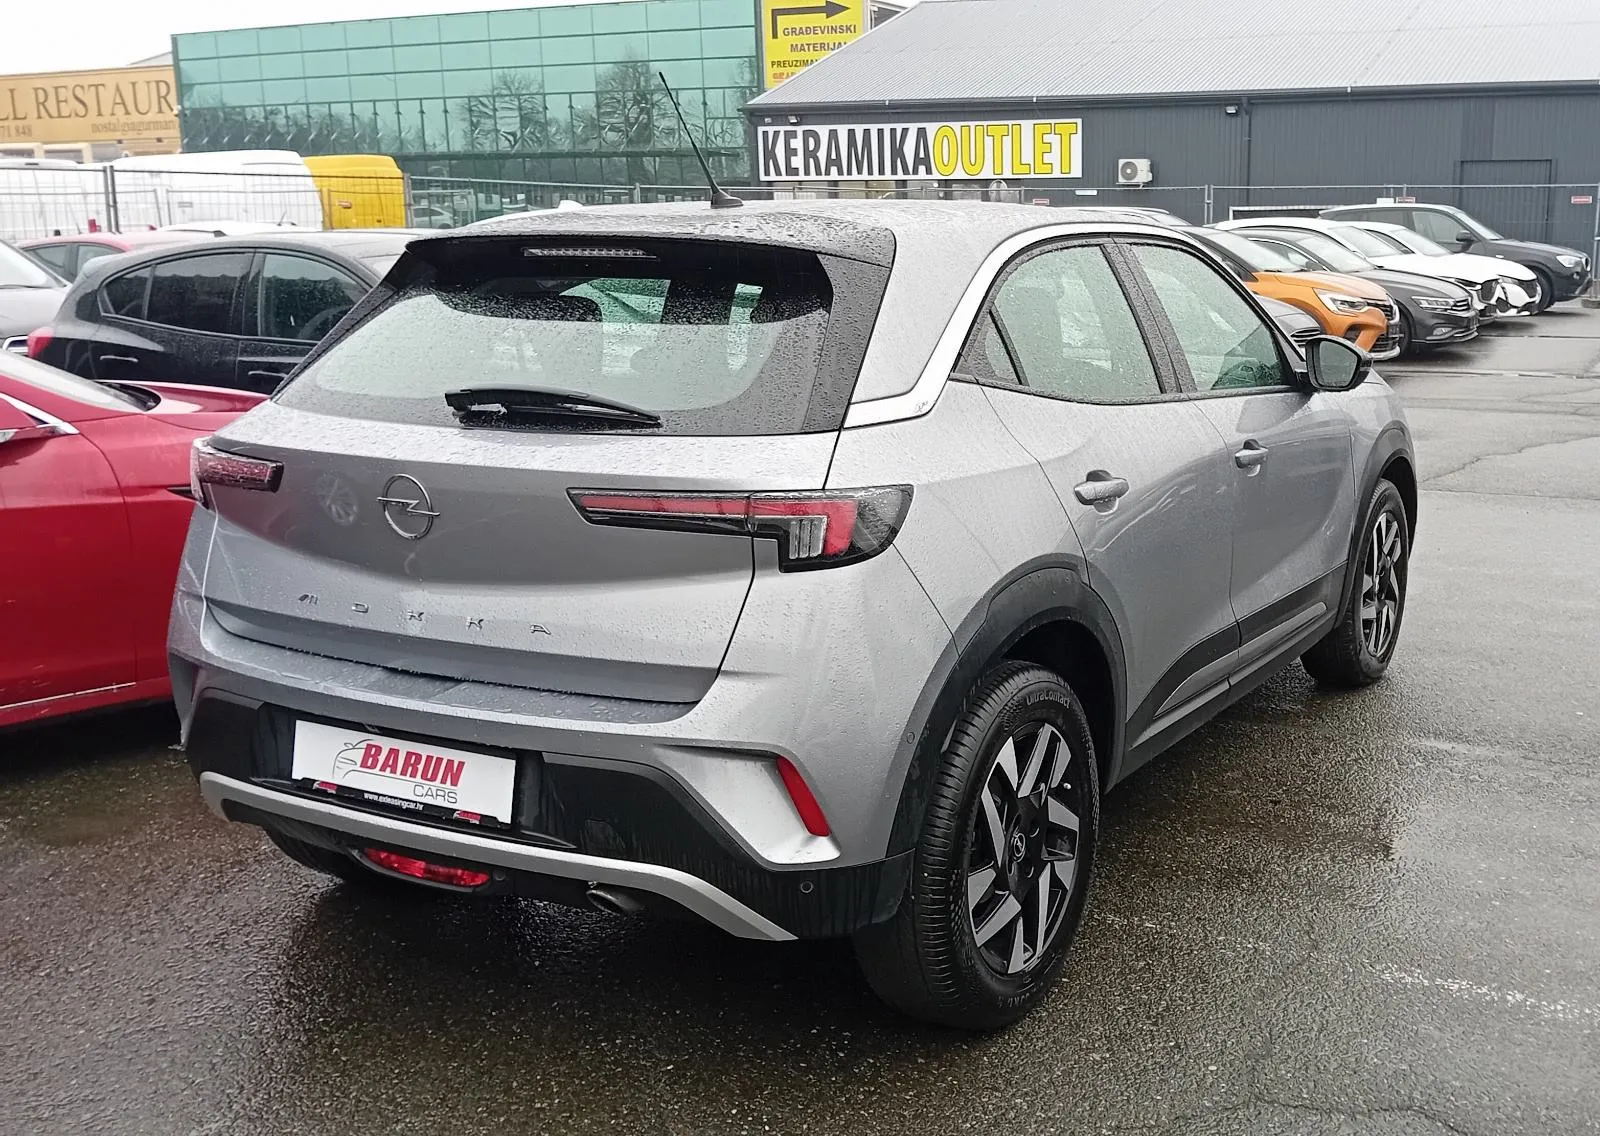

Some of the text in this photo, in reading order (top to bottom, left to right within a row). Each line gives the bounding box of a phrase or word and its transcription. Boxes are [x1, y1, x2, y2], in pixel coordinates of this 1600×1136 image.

[782, 24, 857, 37] GRAĐEVINSKI
[790, 41, 847, 53] MATERIJA
[771, 59, 818, 69] PREUZIMA
[32, 79, 175, 120] RESTAUR
[359, 743, 466, 787] BARUN
[412, 783, 458, 804] CARS
